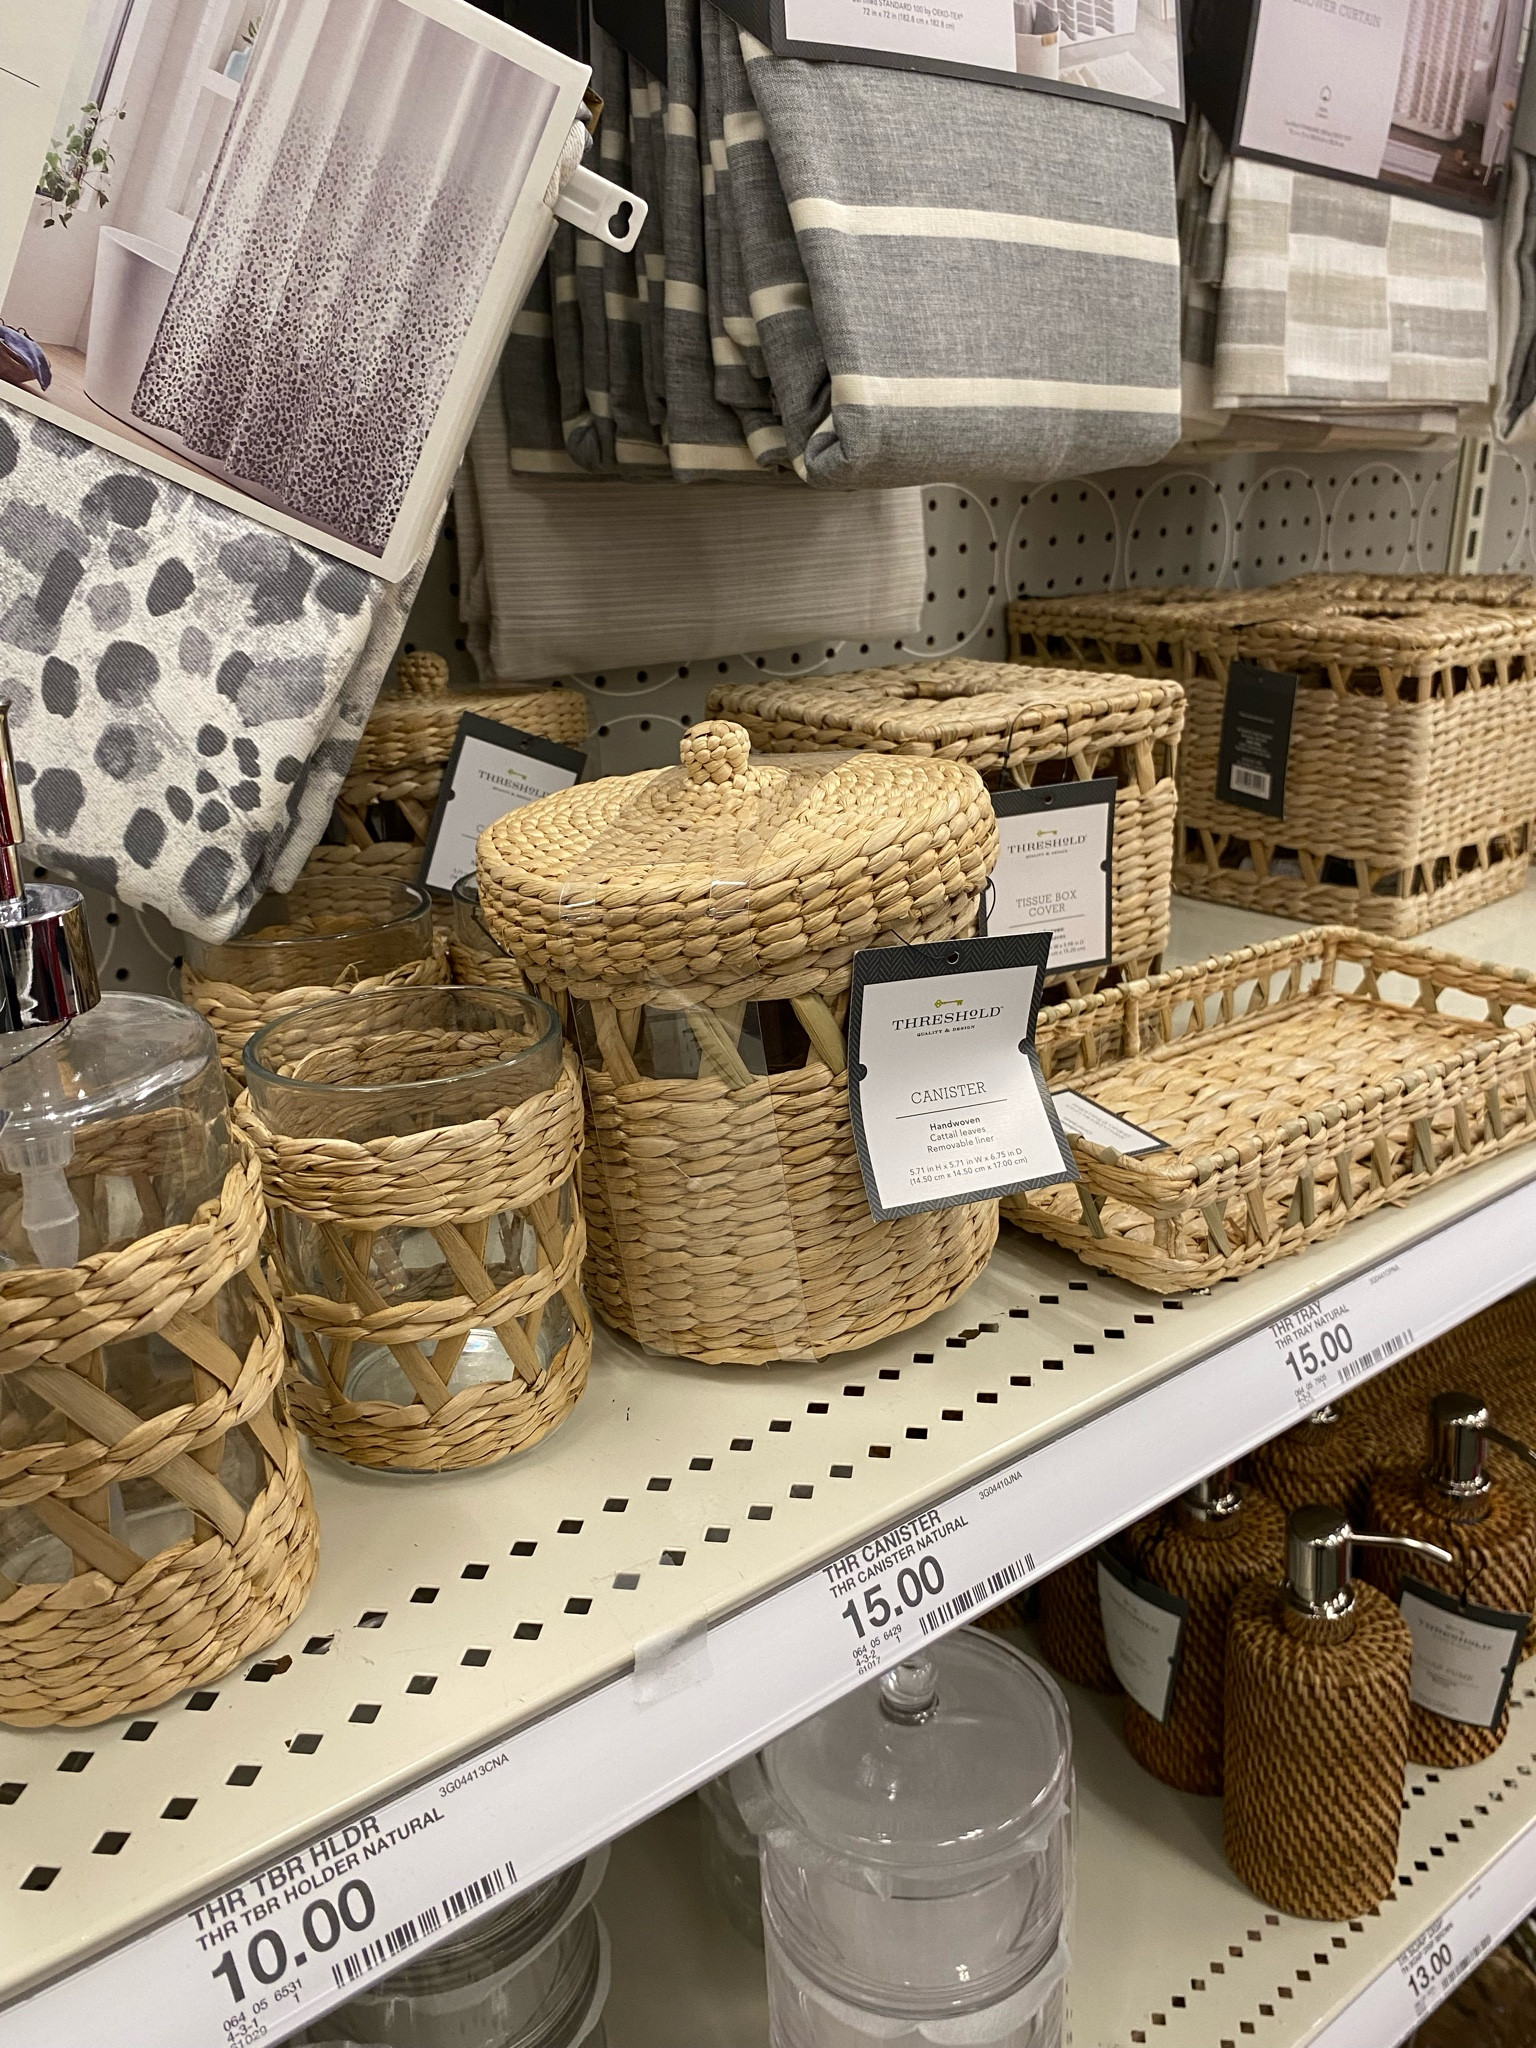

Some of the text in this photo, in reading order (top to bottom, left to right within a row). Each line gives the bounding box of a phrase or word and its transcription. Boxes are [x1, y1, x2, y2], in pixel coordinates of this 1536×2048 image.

[863, 7, 870, 16] 72
[883, 10, 890, 19] 72
[1016, 889, 1077, 908] TISSUE BOX
[1028, 903, 1065, 917] COVER
[892, 1006, 1001, 1031] THRESHOLD
[917, 1029, 942, 1037] QUALITY
[952, 1024, 976, 1032] DESIGN
[911, 1081, 987, 1104] CANISTER
[929, 1116, 981, 1131] Handwoven
[930, 1126, 986, 1142] Cattail leaves
[927, 1135, 994, 1153] Removable liner
[909, 1167, 925, 1176] 5.71
[927, 1165, 934, 1173] in
[935, 1163, 942, 1171] H
[949, 1159, 964, 1169] 5.71
[966, 1157, 973, 1165] in
[990, 1151, 1006, 1161] 6.75
[1016, 1147, 1023, 1155] D
[909, 1175, 932, 1187] (14.50
[953, 1167, 973, 1178] 14.50
[993, 1160, 1012, 1169] 17.00
[1014, 1156, 1028, 1165] cm)
[1269, 1300, 1322, 1338] THR TRAY
[1275, 1304, 1350, 1350] THR TRAY NATURAL
[1285, 1323, 1353, 1381] 15.00
[978, 1470, 1023, 1500] 3G04410JNA
[822, 1509, 942, 1583] THR CANISTER
[829, 1515, 969, 1599] THR CANISTER NATURAL
[842, 1555, 945, 1639] 15.00
[852, 1624, 902, 1659] 064 05 6429
[856, 1635, 901, 1666] 4-3-2 1
[858, 1656, 881, 1675] 61017
[439, 1753, 510, 1798] 3G04413CNA
[188, 1814, 381, 1931] THR TBR HLDR
[196, 1806, 445, 1951] THR TBR HOLDER NATURAL
[212, 1879, 376, 2004] 10.00
[1408, 1944, 1452, 1997] 13.00
[223, 1978, 302, 2032] 064 05 6531
[227, 1992, 300, 2042] 4-3-1 1
